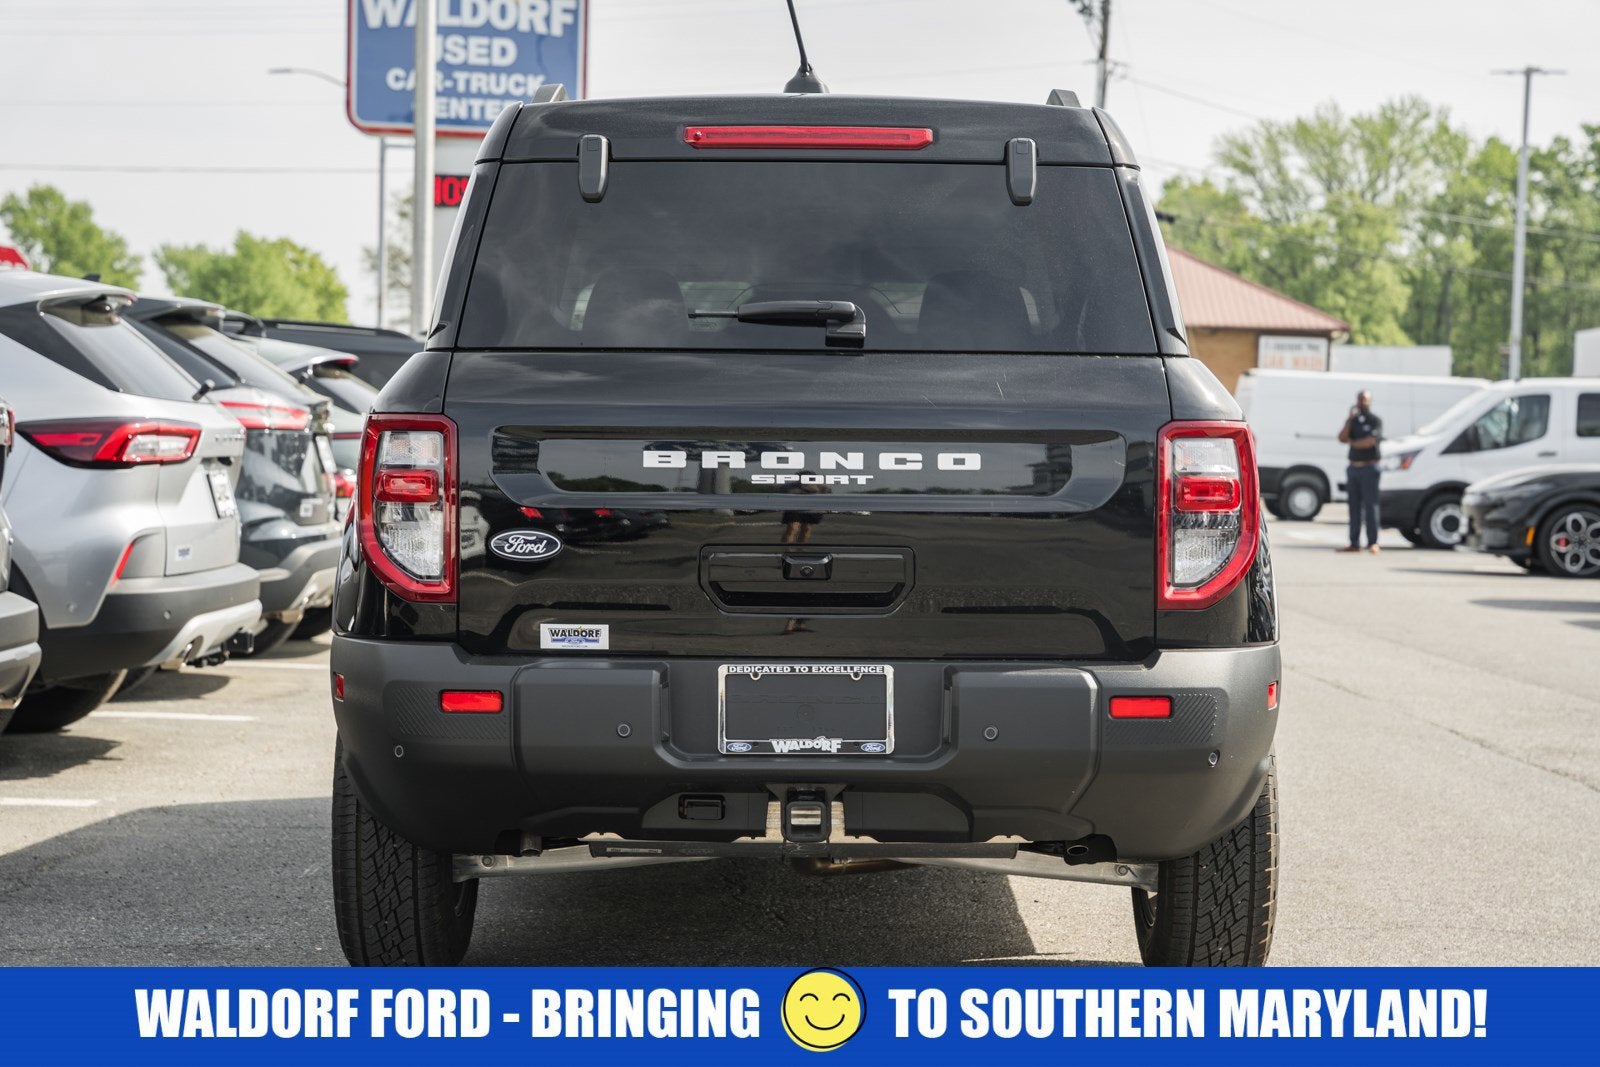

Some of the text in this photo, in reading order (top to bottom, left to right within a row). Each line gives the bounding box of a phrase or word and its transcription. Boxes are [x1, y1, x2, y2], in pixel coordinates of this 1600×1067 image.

[413, 97, 515, 120] ENTE
[642, 450, 981, 470] BRONCO
[751, 474, 873, 485] SPORT
[504, 534, 548, 553] Ford
[549, 629, 602, 638] WALDORF
[729, 665, 884, 673] DEDICATED TO EXCELLENCE
[771, 738, 842, 753] WALDORF
